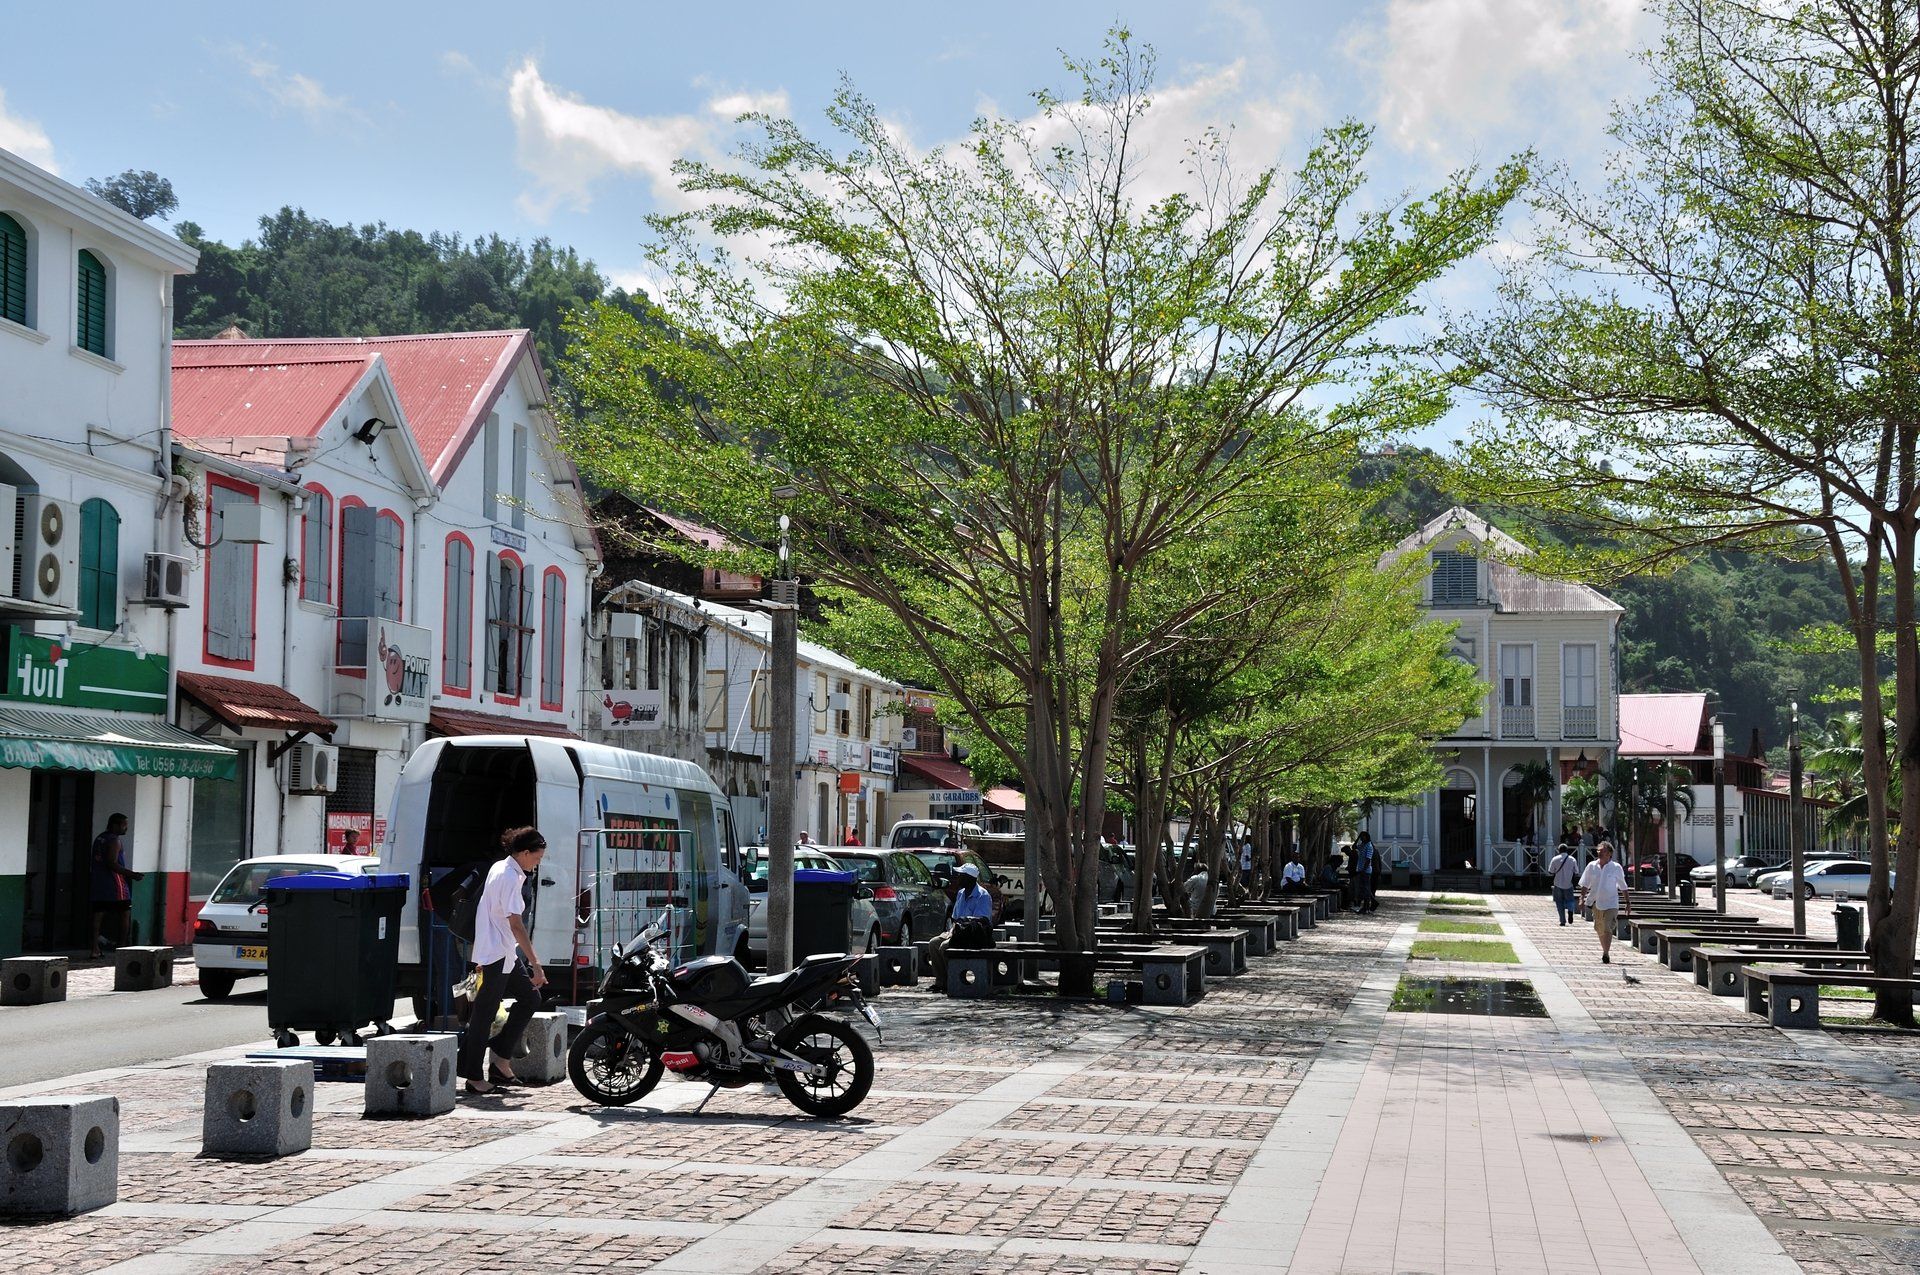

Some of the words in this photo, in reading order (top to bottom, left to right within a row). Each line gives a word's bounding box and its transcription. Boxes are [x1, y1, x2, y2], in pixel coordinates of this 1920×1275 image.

[404, 654, 430, 676] POINT
[402, 671, 428, 699] MAT
[632, 703, 660, 712] POINT
[152, 757, 175, 771] 0596
[241, 948, 257, 958] 932
